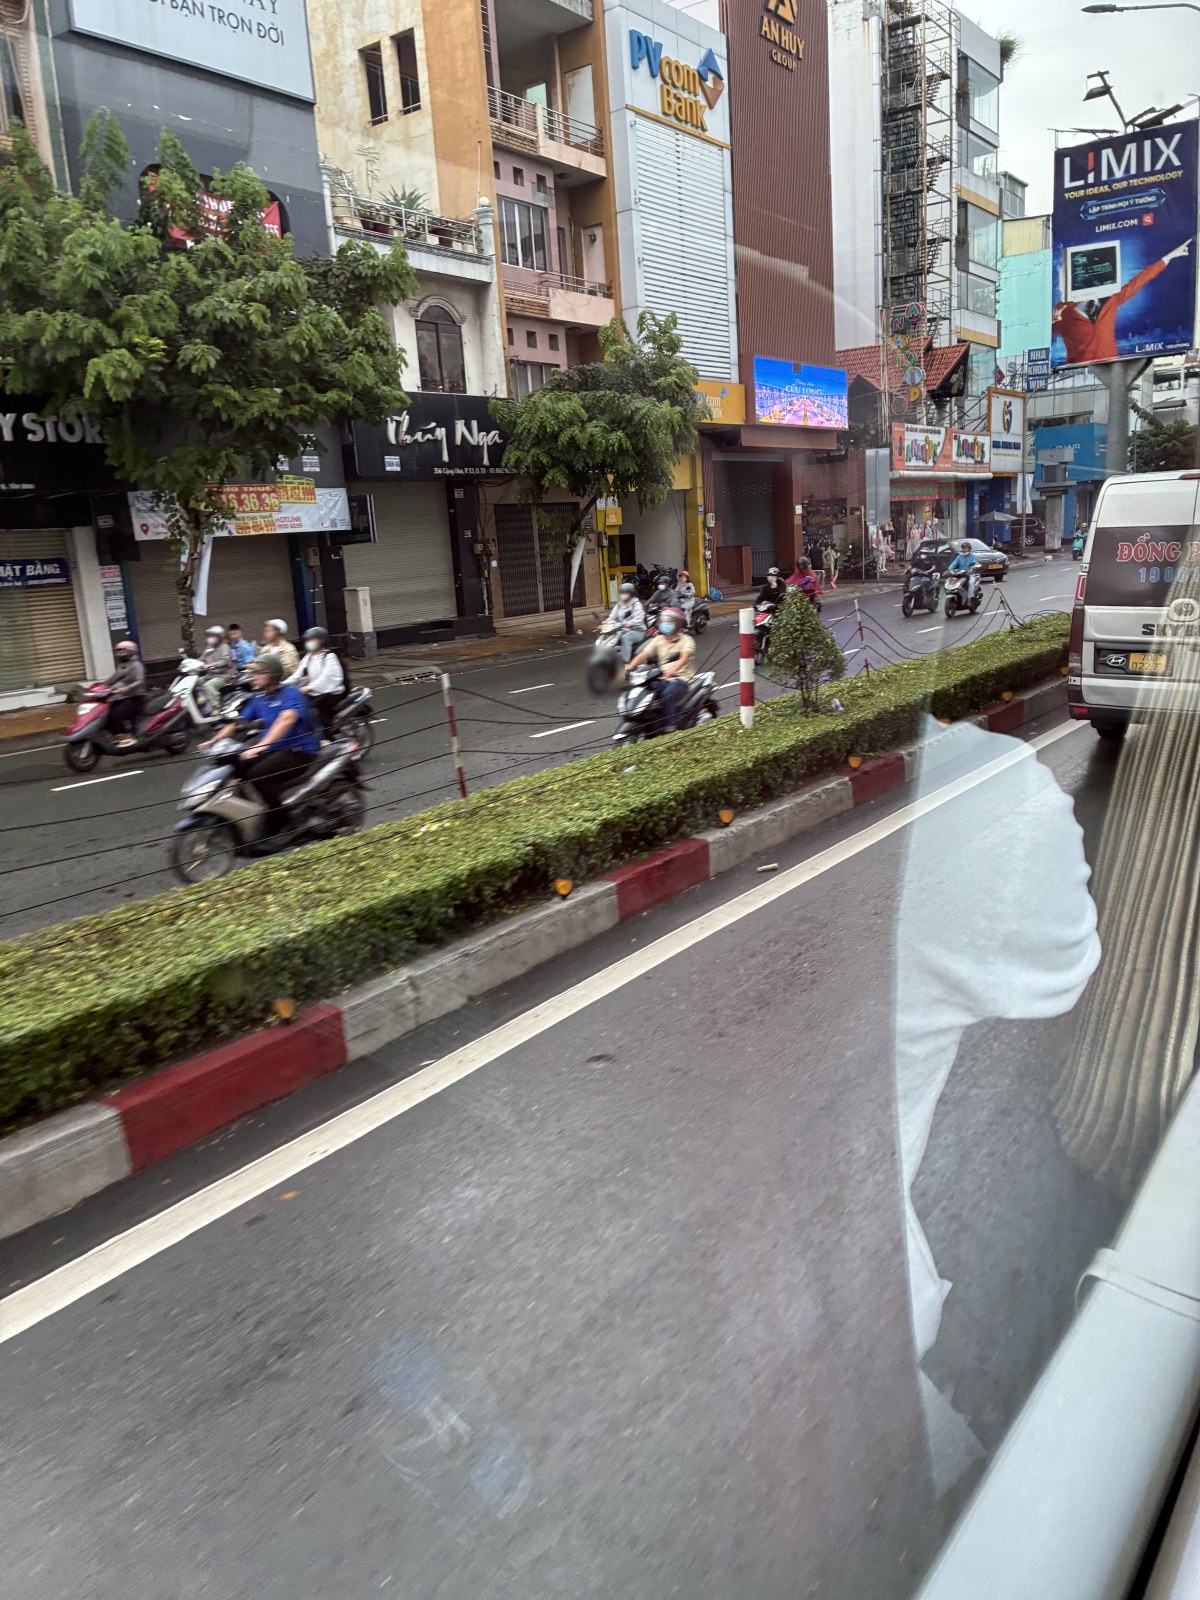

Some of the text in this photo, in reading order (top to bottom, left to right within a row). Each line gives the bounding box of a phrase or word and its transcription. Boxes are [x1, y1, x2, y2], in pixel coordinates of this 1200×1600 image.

[208, 5, 252, 35] TRỌN
[257, 21, 285, 46] ĐỜI
[760, 15, 805, 60] AN HUY
[772, 49, 797, 71] GROUP
[660, 84, 708, 132] Bank
[1064, 170, 1184, 200] YOUR IDEAS, OUR TECHNOLOGY
[1095, 218, 1138, 233] LIMIX.COM
[1028, 365, 1047, 375] KHOA
[1030, 350, 1046, 360] NHA
[386, 410, 503, 466] Thúy Nga
[1117, 532, 1182, 562] ĐỒNG
[26, 560, 60, 577] BẰNG
